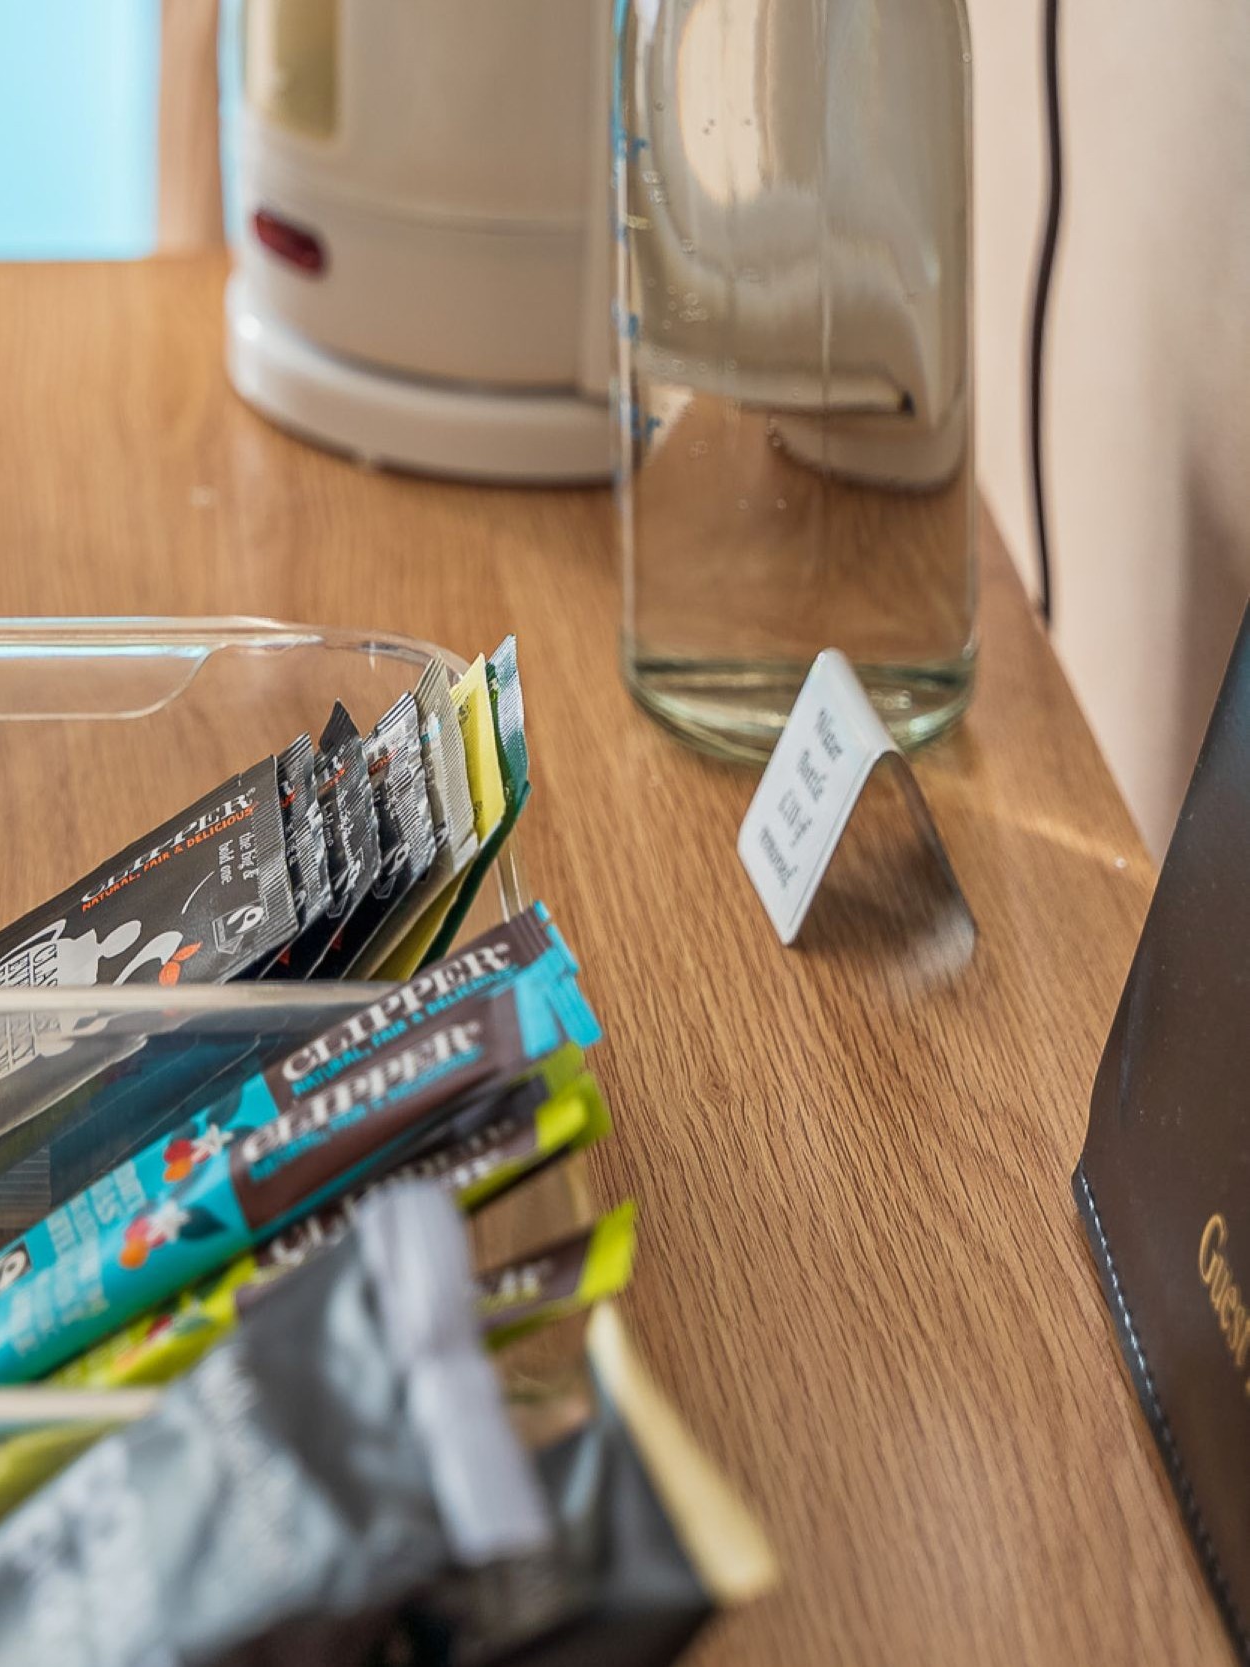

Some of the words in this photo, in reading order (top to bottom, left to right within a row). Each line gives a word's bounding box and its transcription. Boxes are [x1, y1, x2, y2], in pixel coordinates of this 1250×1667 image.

[218, 839, 235, 865] bold
[238, 831, 255, 850] the
[82, 872, 141, 912] NATURAL,
[144, 851, 171, 872] FAIR
[173, 843, 184, 855] &
[185, 806, 255, 849] DELICIOUS
[237, 847, 257, 870] big
[220, 864, 233, 886] one
[282, 945, 509, 1081] CLIPPER
[370, 1018, 408, 1047] FAIR
